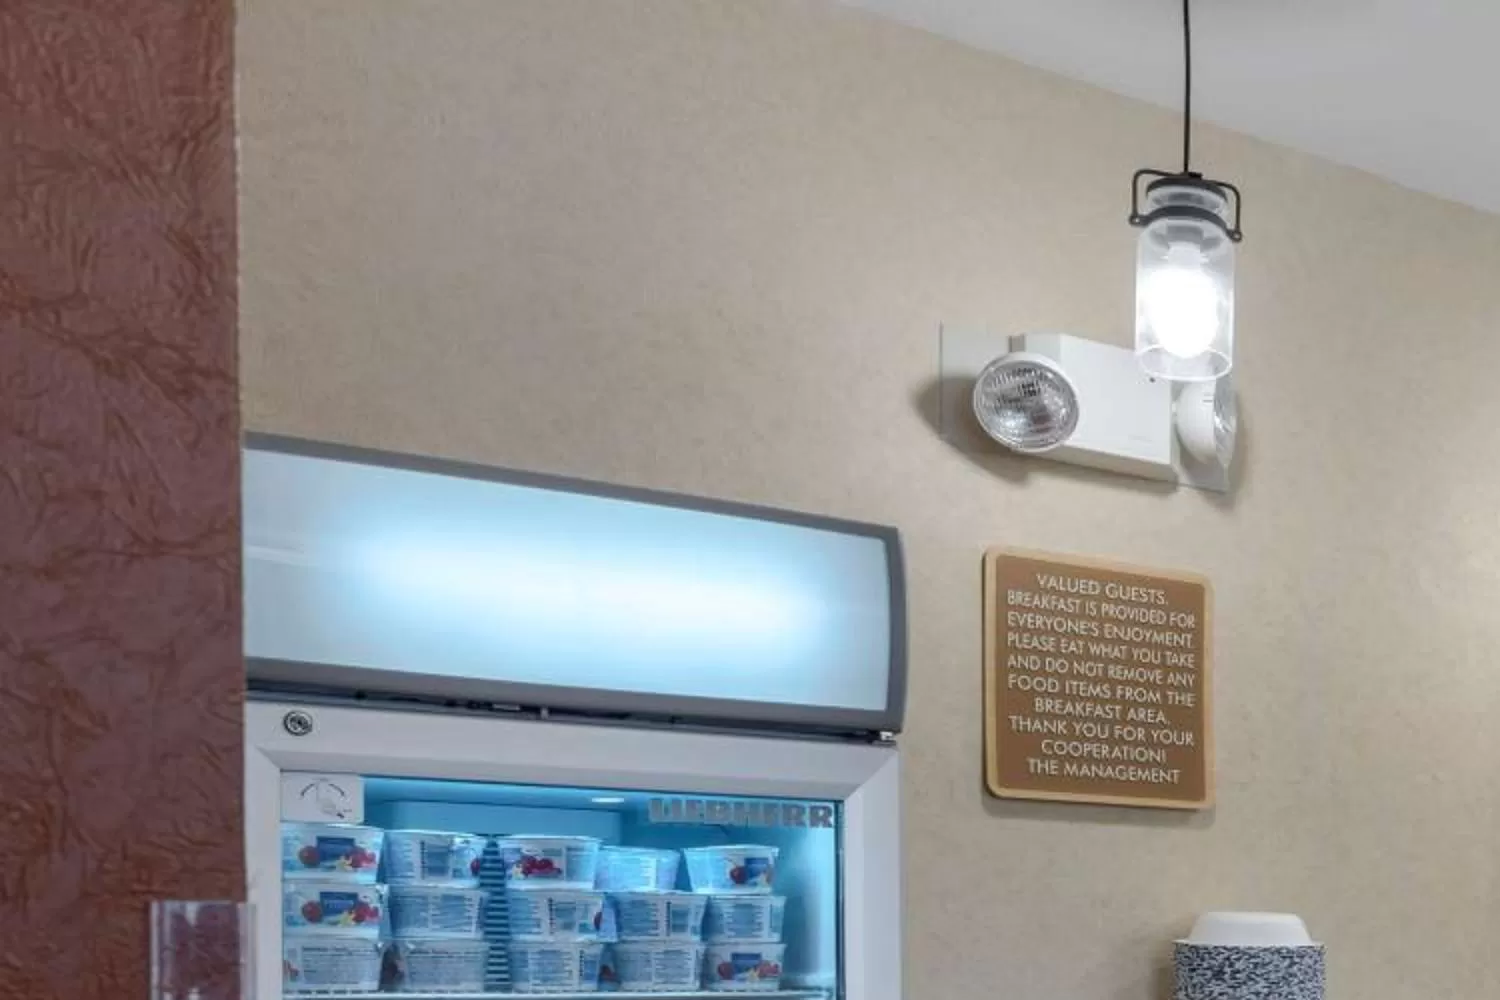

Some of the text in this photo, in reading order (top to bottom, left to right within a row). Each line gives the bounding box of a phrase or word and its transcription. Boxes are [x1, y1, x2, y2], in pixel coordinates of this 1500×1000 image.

[1036, 573, 1100, 595] VALUED
[1007, 590, 1195, 629] BREAKFAST IS PROVIDED FOR
[1007, 633, 1195, 669] PLEASE EAT WHAT YOU TAKE
[1007, 654, 1195, 688] AND DO NOT REMOVE ANY
[1008, 673, 1196, 708] FOOD ITEMS FROM THE
[1035, 697, 1123, 720] BREAKFAST
[1008, 715, 1194, 746] THANK YOU FOR YOUR
[1027, 758, 1181, 785] THE MANAGEMENT
